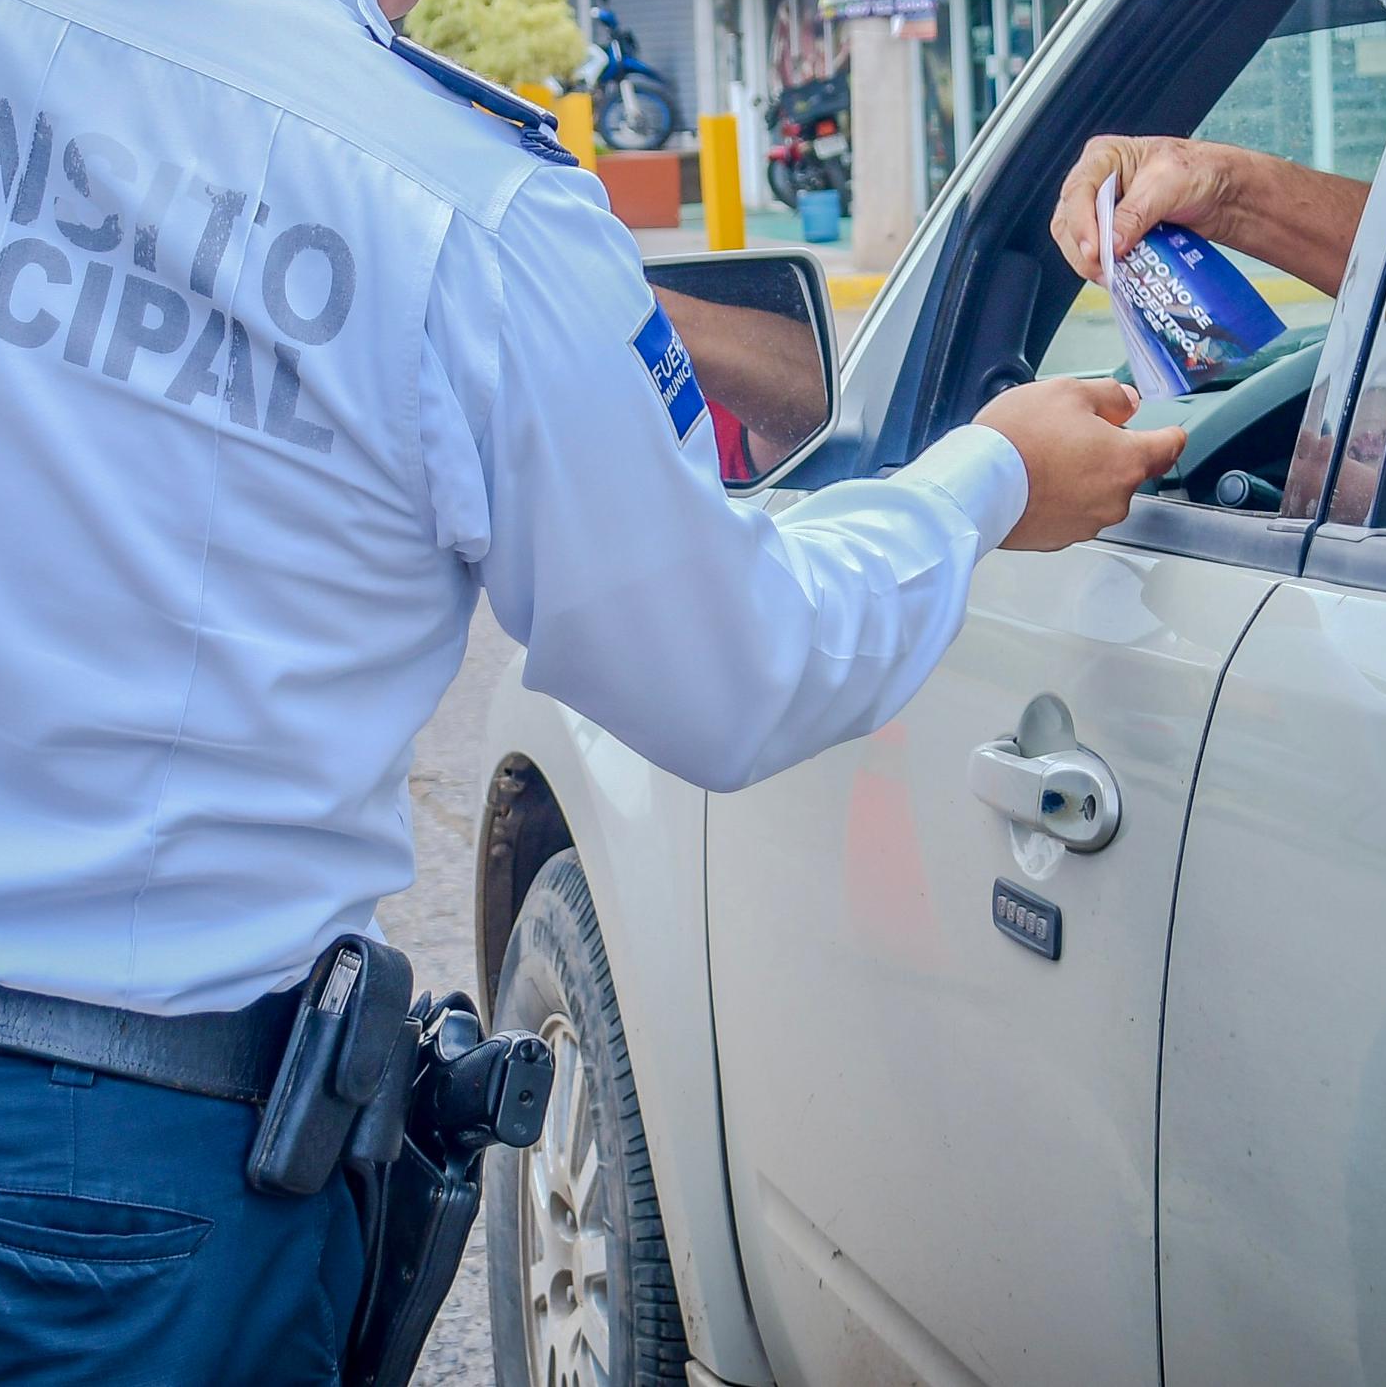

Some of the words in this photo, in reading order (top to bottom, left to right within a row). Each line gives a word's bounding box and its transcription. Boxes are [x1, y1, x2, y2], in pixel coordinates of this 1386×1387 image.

[1143, 270, 1174, 307] VER
[1167, 277, 1193, 305] NO
[1189, 305, 1214, 330] SE
